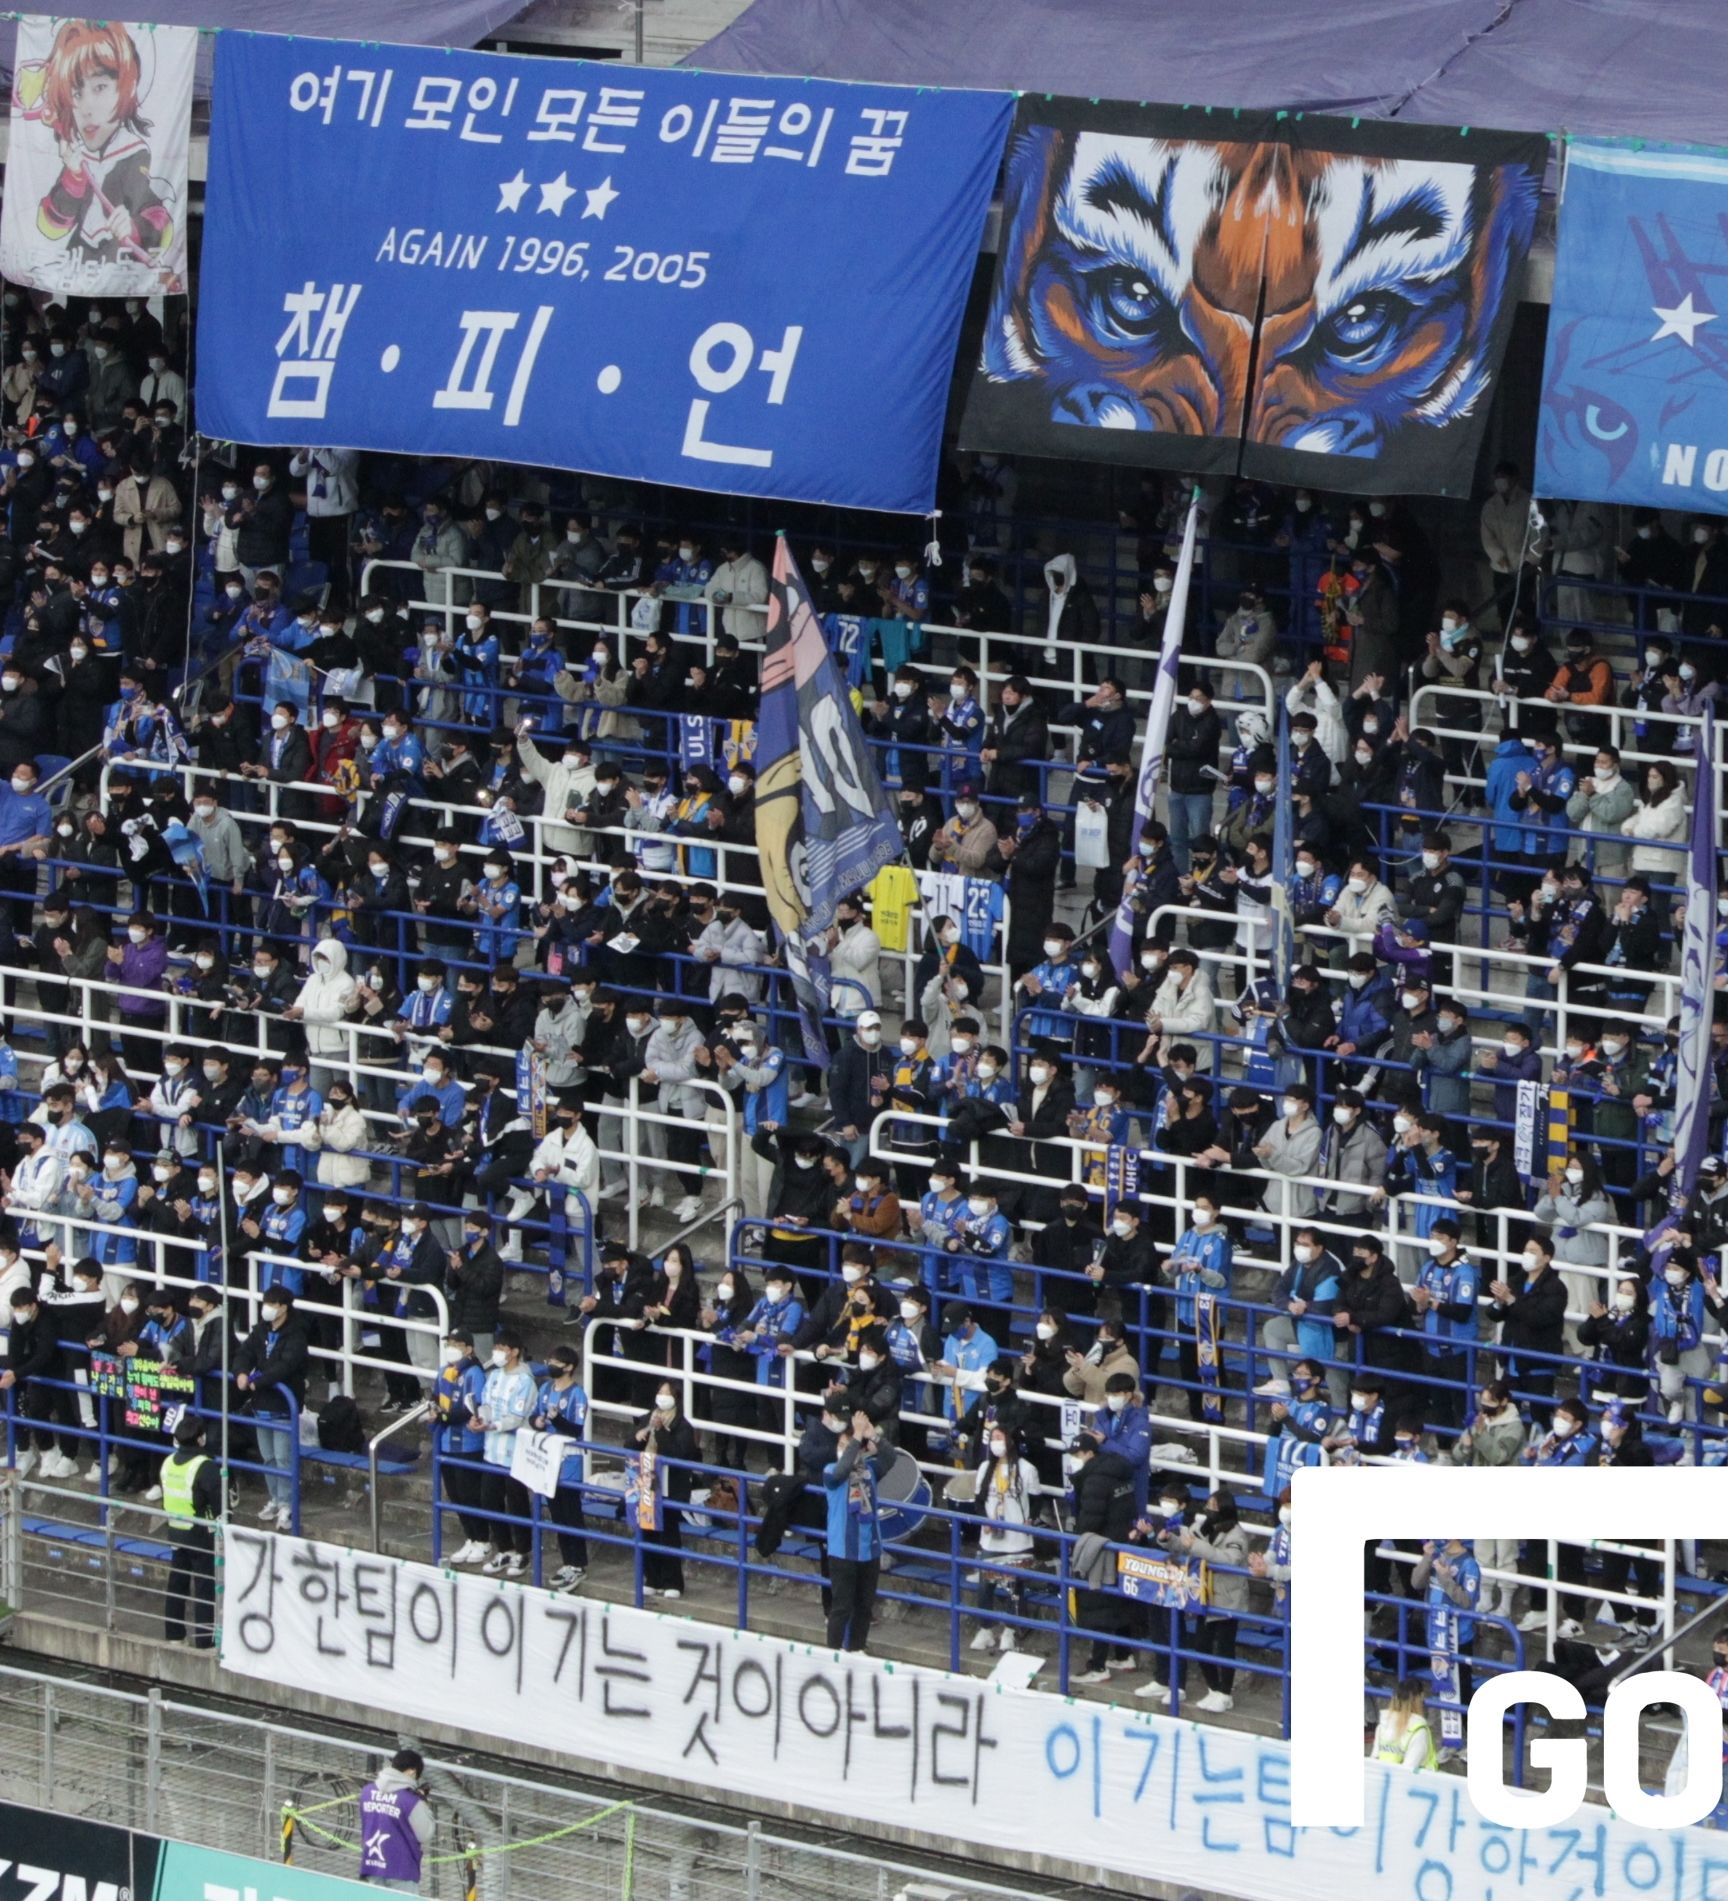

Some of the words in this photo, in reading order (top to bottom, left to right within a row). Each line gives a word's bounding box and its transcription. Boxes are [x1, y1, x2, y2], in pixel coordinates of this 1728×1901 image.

[289, 64, 394, 128] 여기
[404, 75, 520, 144] 모인
[526, 86, 646, 154] 모든
[658, 96, 835, 168] 이들의
[844, 107, 910, 177] 꿈
[375, 226, 489, 270] AGAIN
[497, 235, 591, 283] 1996,
[603, 245, 711, 289] 2005
[838, 620, 860, 653] 72
[967, 886, 992, 919] 23
[1126, 1152, 1138, 1194] UHFC
[1122, 1574, 1140, 1597] 66
[231, 1532, 460, 1680] 강한팀이
[480, 1592, 654, 1720] 이기는
[362, 1801, 401, 1819] REPORTER
[370, 1789, 398, 1805] TEAM
